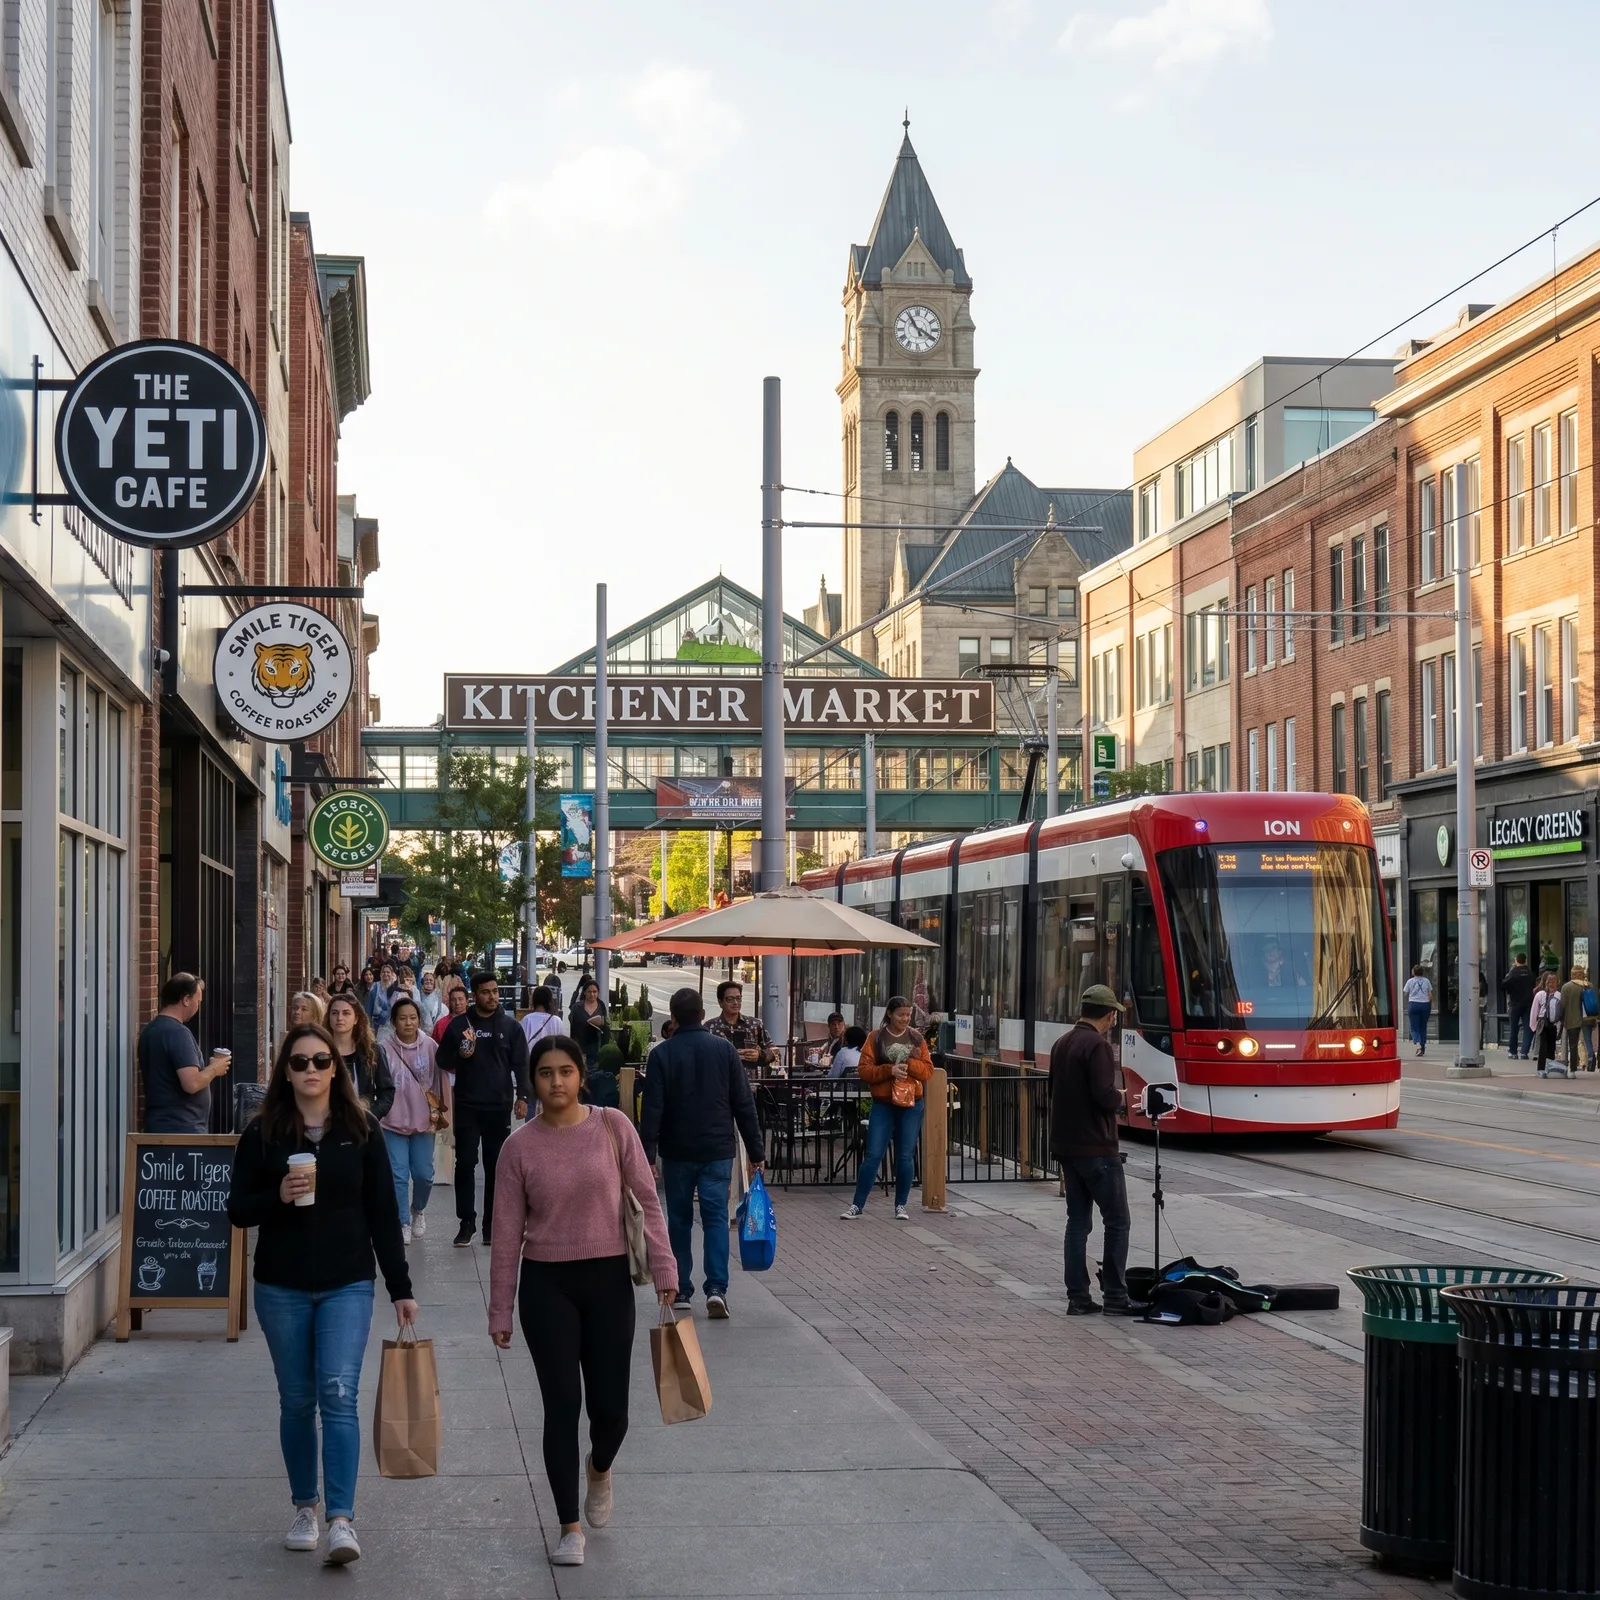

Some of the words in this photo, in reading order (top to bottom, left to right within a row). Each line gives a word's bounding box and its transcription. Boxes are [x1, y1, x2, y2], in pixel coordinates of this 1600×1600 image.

[134, 374, 189, 400] THE
[84, 407, 238, 470] YETI
[115, 476, 208, 509] CAFE
[229, 613, 282, 657] SMILE
[288, 613, 339, 660] TIGER
[230, 690, 272, 728] COFFEE
[276, 690, 337, 730] ROASTERS
[462, 685, 749, 722] KITCHENER
[784, 687, 980, 723] MARKET
[1264, 820, 1300, 835] ION
[1490, 816, 1533, 846] LEGACY
[1535, 809, 1582, 841] GREENS
[141, 1152, 185, 1181] Smile
[138, 1188, 177, 1210] COFFEE
